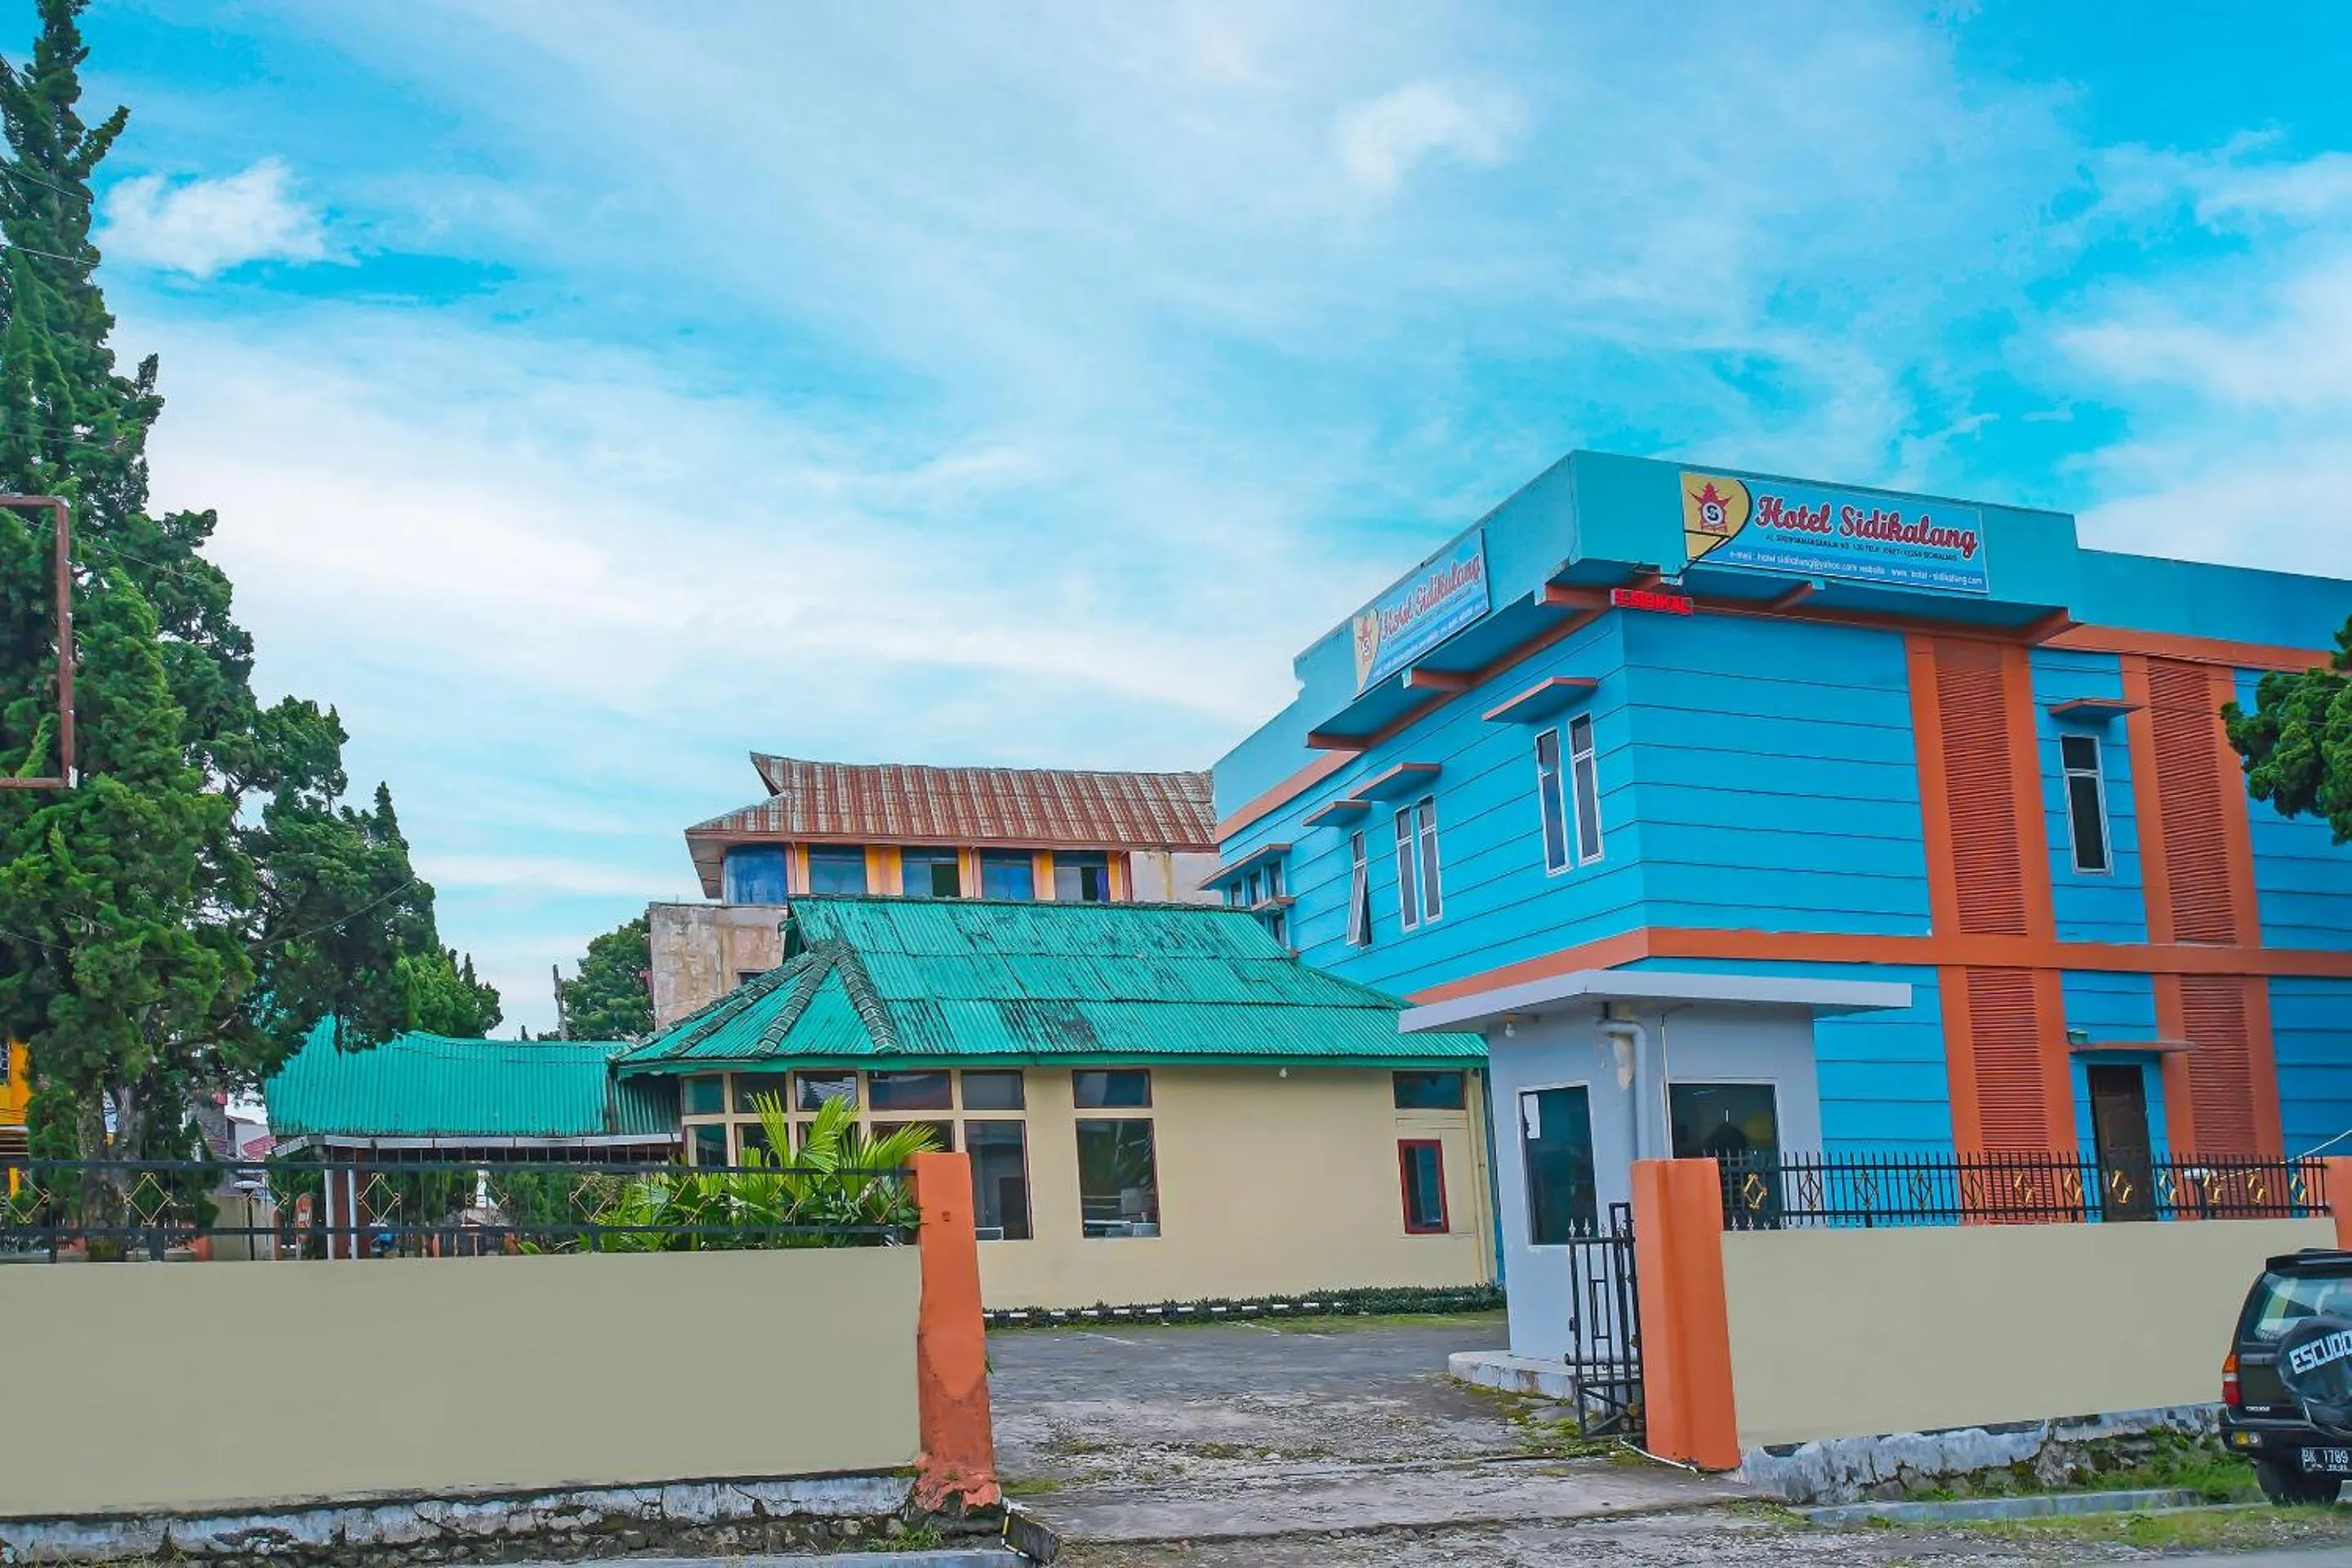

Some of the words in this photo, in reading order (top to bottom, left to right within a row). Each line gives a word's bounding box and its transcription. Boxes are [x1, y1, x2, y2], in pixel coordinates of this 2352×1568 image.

[1707, 505, 1719, 521] S
[1755, 496, 1833, 535] Hotel
[1838, 504, 1978, 560] Sidikalang
[2289, 1330, 2352, 1374] ESCUDO
[2323, 1450, 2349, 1463] 1789
